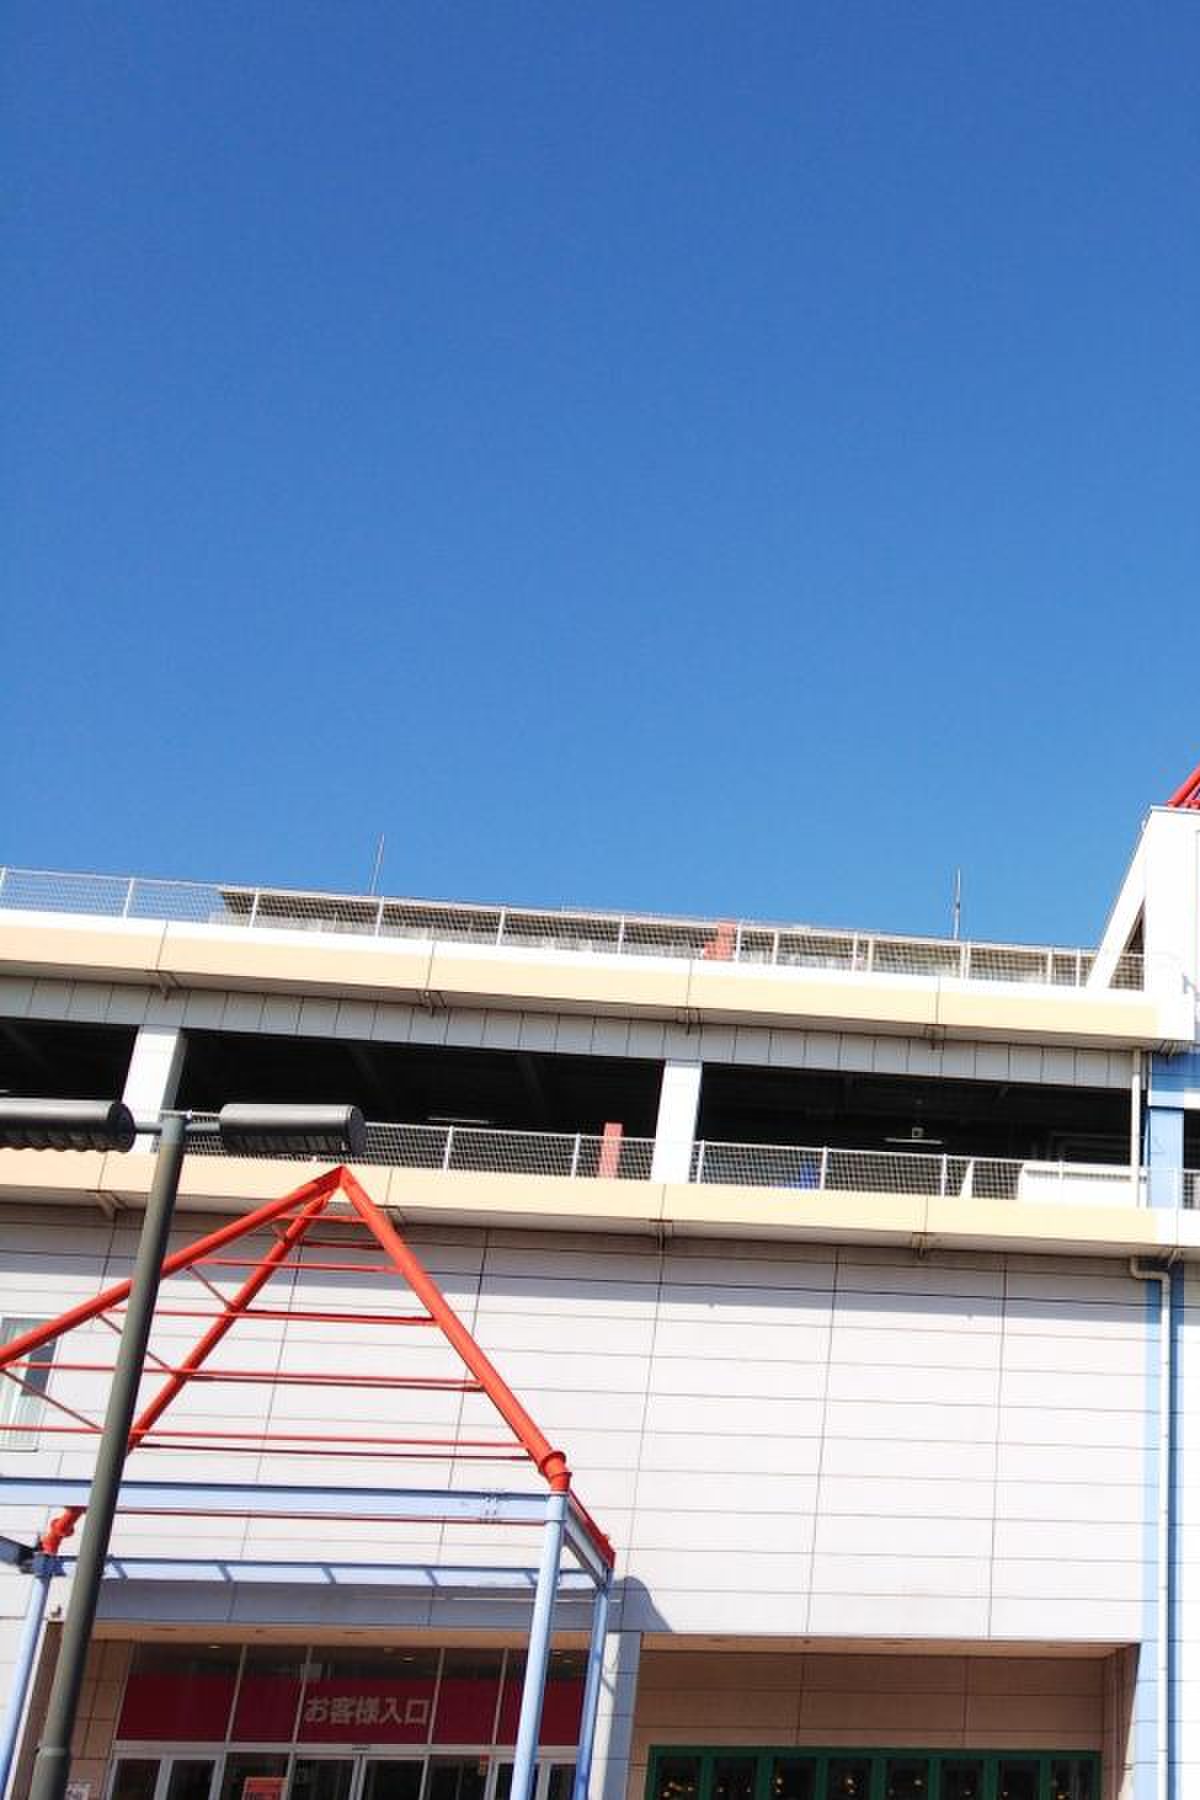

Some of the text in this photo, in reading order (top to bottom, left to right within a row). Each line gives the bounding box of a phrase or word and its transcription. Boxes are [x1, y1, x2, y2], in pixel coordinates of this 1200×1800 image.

[304, 1695, 430, 1726] お客様入口
